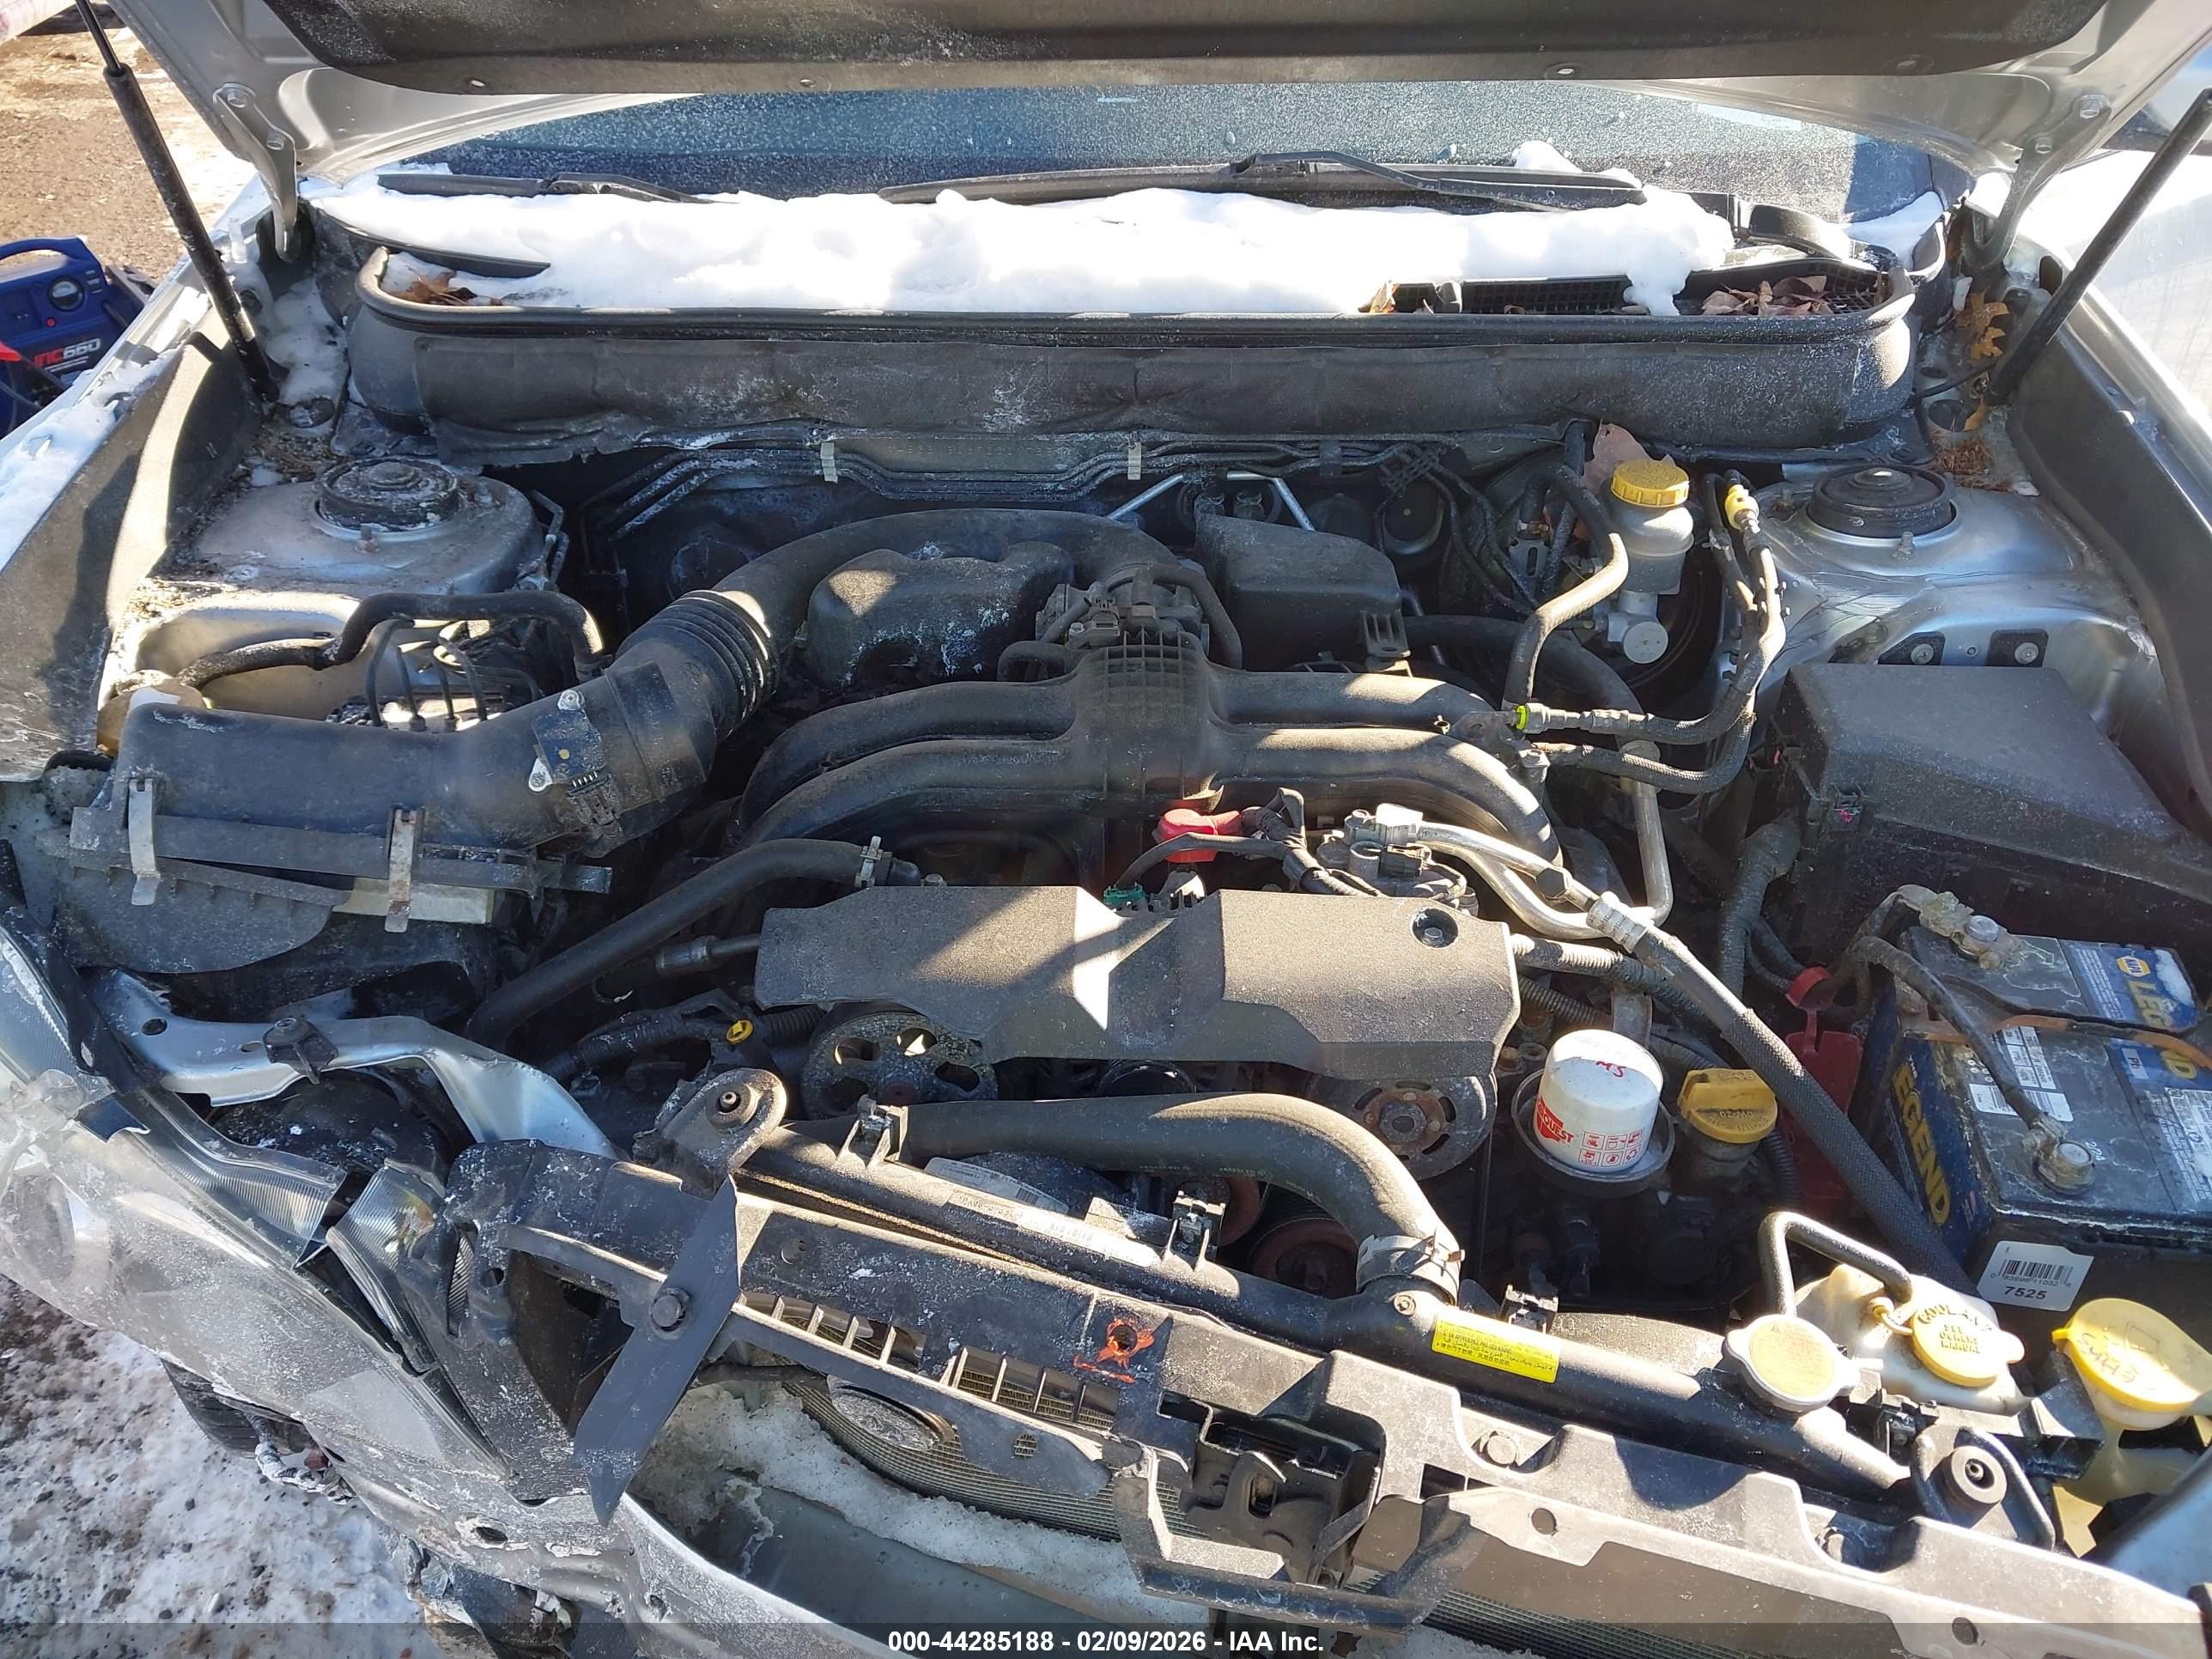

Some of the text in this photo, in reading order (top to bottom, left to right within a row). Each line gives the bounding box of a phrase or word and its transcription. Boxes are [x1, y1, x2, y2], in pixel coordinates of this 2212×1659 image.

[33, 338, 100, 368] NC660
[2124, 957, 2143, 975] NAPA
[1595, 1060, 1626, 1078] MS
[2127, 1056, 2138, 1070] Pb
[1893, 1062, 1951, 1227] EGEND
[2004, 1286, 2048, 1300] 7525
